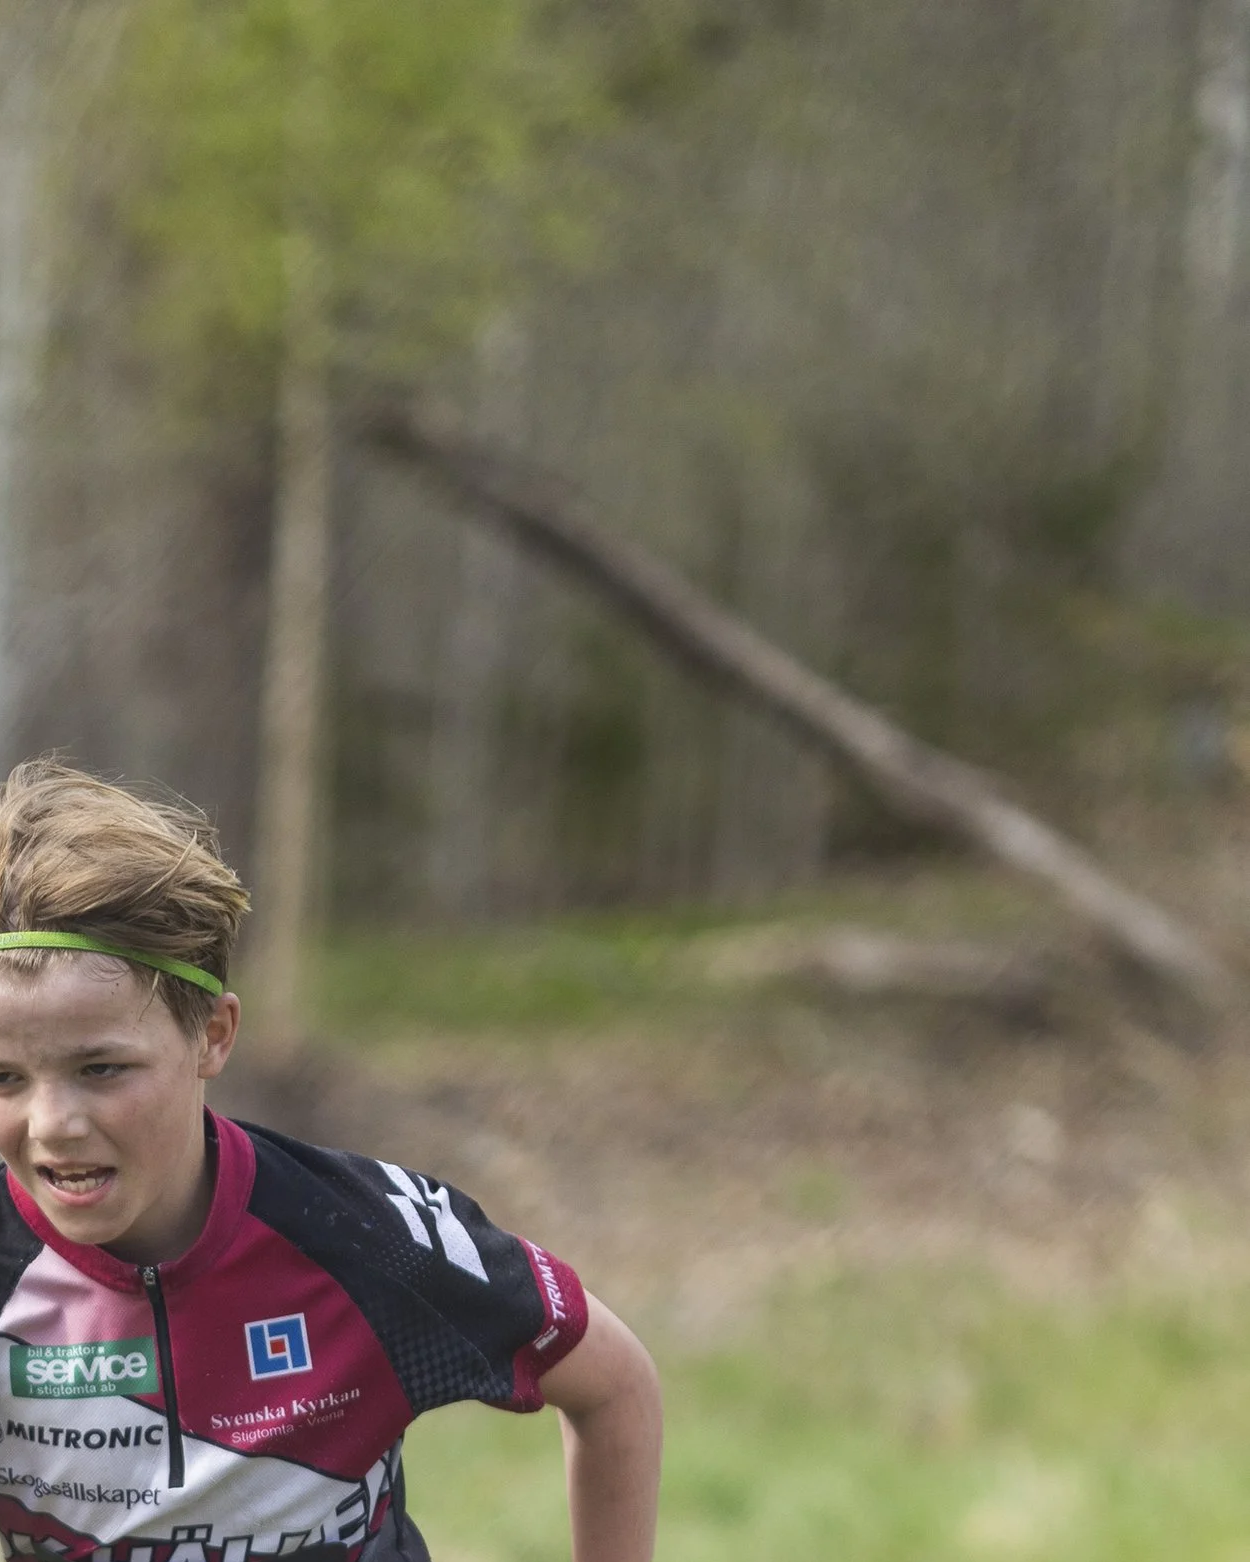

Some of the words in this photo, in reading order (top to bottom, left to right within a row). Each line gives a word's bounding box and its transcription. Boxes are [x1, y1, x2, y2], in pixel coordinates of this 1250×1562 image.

[27, 1347, 43, 1358] bil
[44, 1347, 54, 1357] &
[56, 1345, 96, 1357] traktor
[26, 1352, 148, 1385] service
[36, 1383, 97, 1397] stigtomta
[100, 1382, 117, 1393] ab
[210, 1405, 286, 1429] Svenska
[291, 1387, 361, 1417] Kyrkan
[6, 1419, 164, 1450] MILTRONIC
[231, 1423, 295, 1445] Stigtomta
